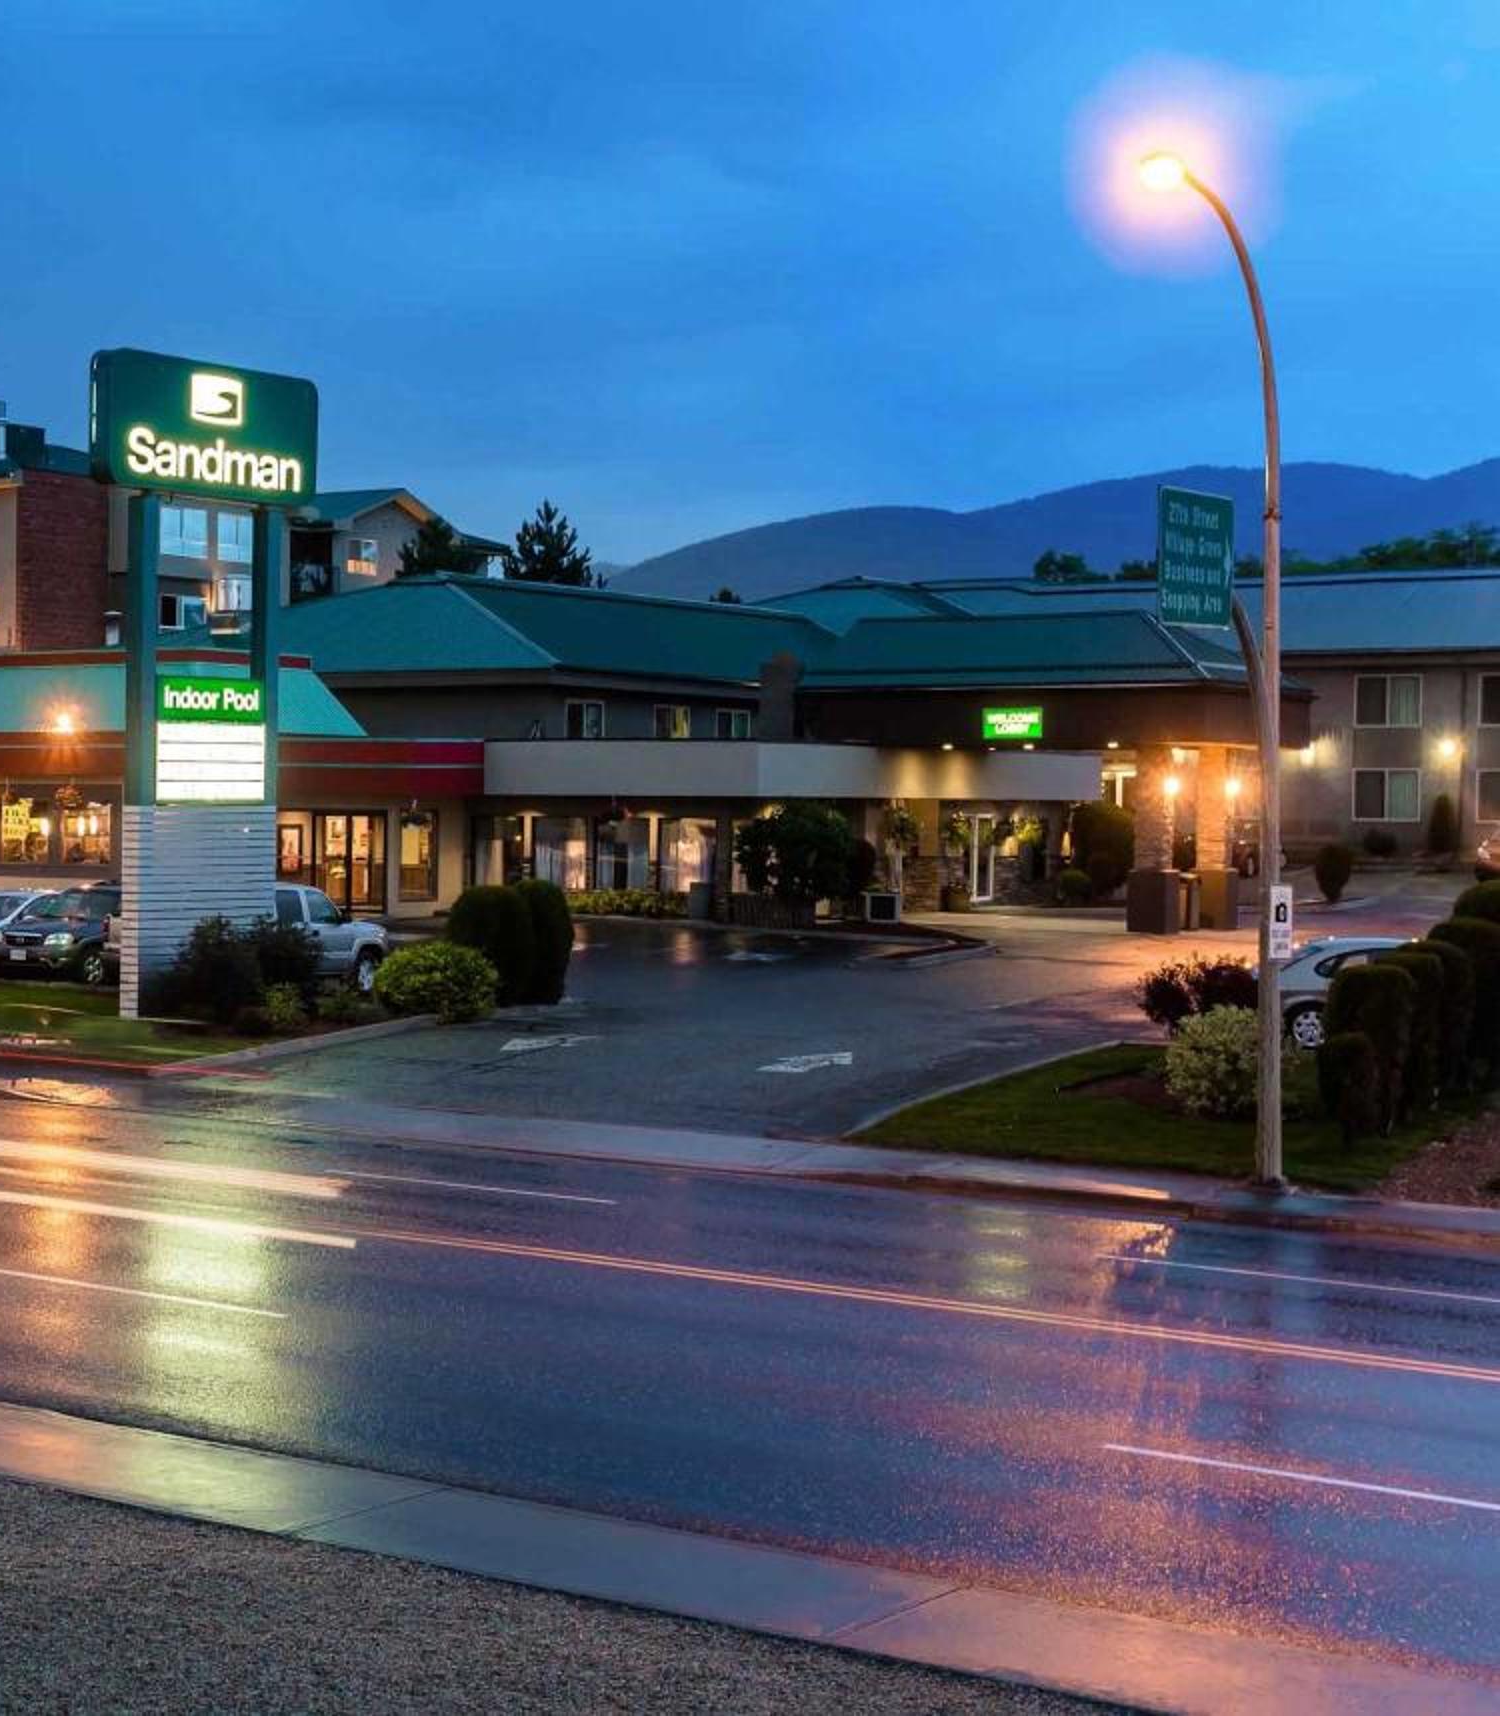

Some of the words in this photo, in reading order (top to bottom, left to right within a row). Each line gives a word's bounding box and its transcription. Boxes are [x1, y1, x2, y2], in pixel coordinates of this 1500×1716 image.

[127, 426, 302, 493] Sandman
[163, 685, 220, 710] Indoor
[223, 687, 260, 711] Pool
